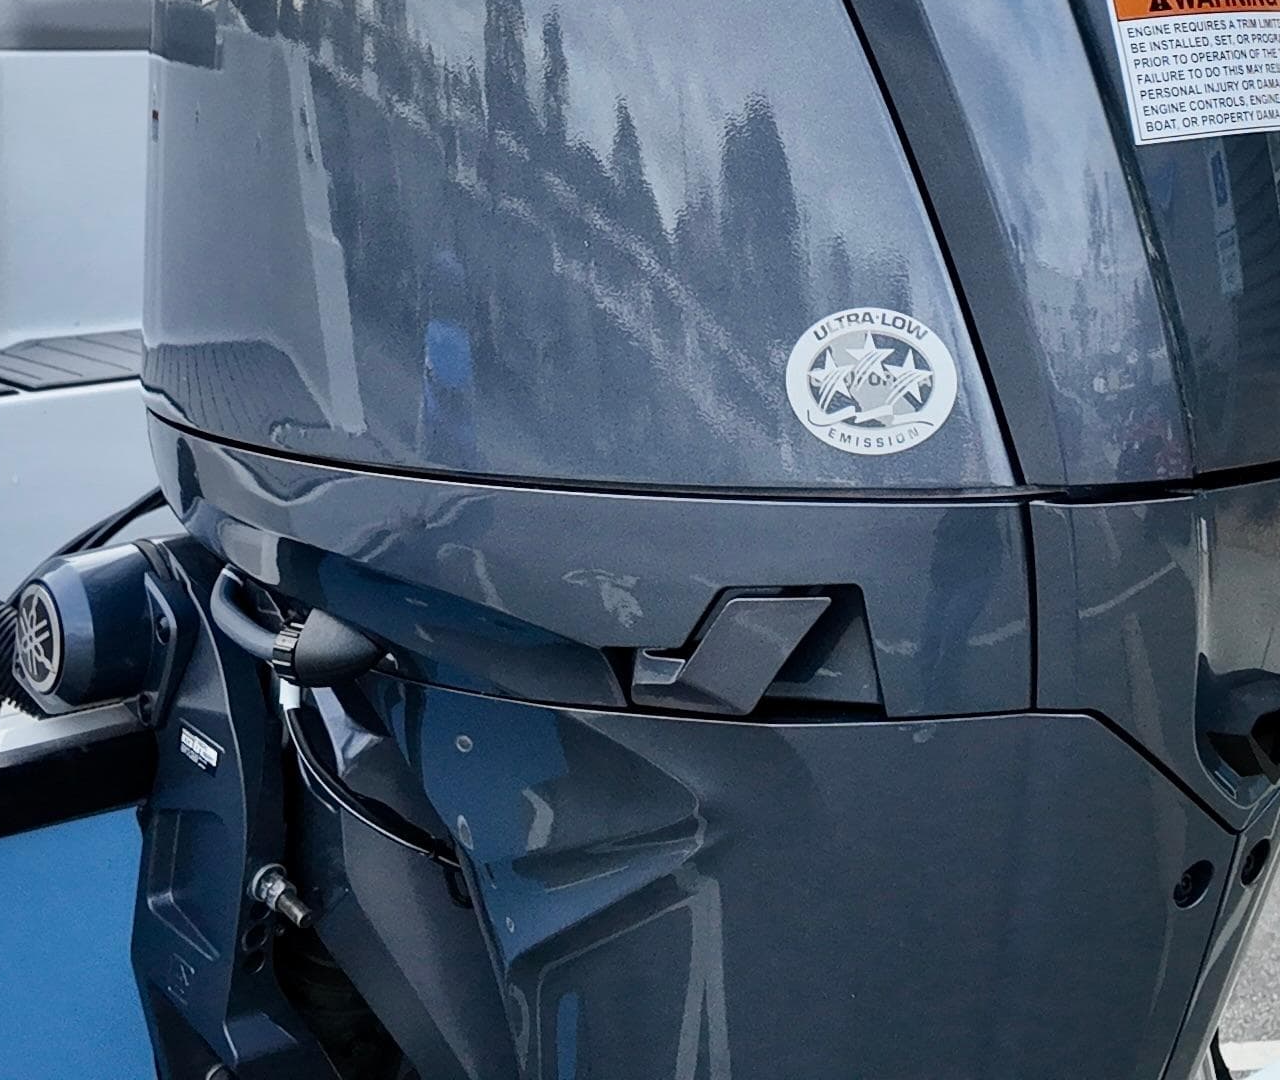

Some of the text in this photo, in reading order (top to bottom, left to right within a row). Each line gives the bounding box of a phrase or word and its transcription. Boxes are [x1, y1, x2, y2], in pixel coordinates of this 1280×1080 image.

[1127, 23, 1171, 38] ENGINE
[1173, 19, 1227, 33] REQUIRES
[1229, 20, 1235, 30] A
[1237, 19, 1257, 29] TRIM
[1130, 42, 1147, 53] BE
[1236, 34, 1250, 44] OR
[1133, 56, 1170, 69] PRIOR
[1172, 54, 1188, 65] TO
[1191, 48, 1247, 63] OPERATION
[1249, 49, 1260, 58] OF
[1262, 48, 1278, 58] THE
[1136, 70, 1186, 84] FAILURE
[1187, 68, 1203, 79] TO
[1205, 66, 1220, 78] DO
[1222, 65, 1245, 76] THIS
[1245, 63, 1264, 74] MAY
[1140, 85, 1202, 100] PERSONAL
[1204, 81, 1239, 93] INJURY
[1241, 80, 1255, 90] OR
[1143, 102, 1187, 116] ENGINE
[1250, 94, 1280, 105] ENGINE
[1182, 117, 1199, 128] OR
[1201, 110, 1255, 126] PROPERTY
[827, 427, 920, 448] EMISSION
